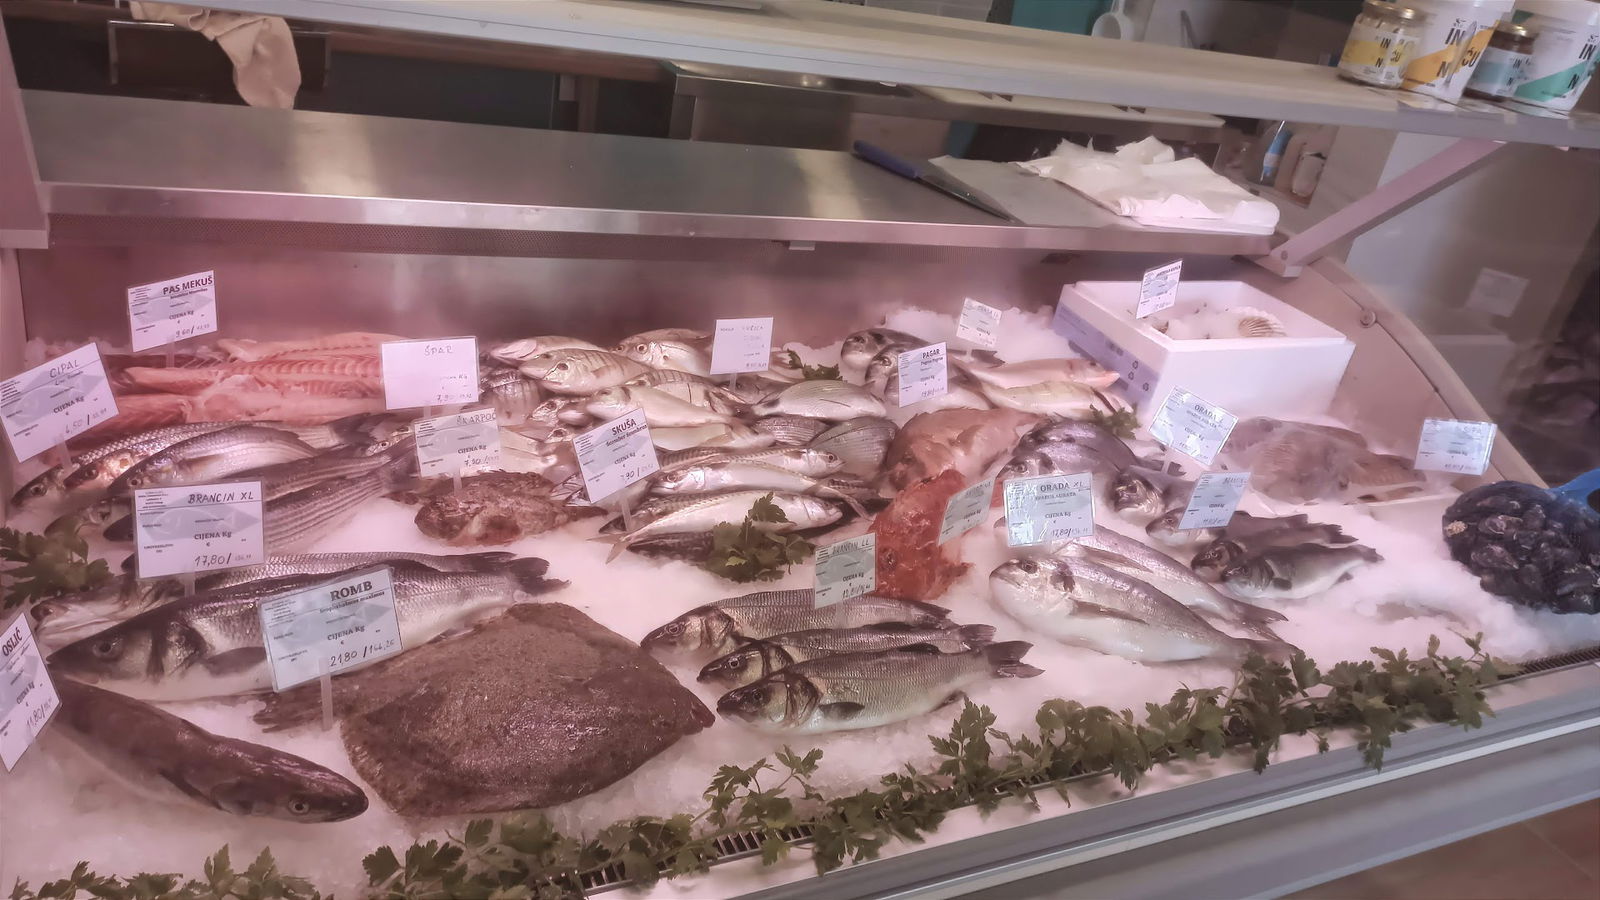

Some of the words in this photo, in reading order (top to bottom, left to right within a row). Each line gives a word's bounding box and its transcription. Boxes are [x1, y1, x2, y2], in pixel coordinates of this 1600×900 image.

[163, 284, 180, 295] PAS
[182, 275, 213, 291] MEKUŠ
[611, 418, 637, 436] SKUŠA
[1040, 482, 1070, 492] ORADA
[188, 492, 234, 504] BRANCIN
[241, 491, 254, 501] XL
[330, 580, 373, 601] ROMB
[2, 627, 23, 657] OSLIĆ
[327, 629, 353, 641] CIJENA
